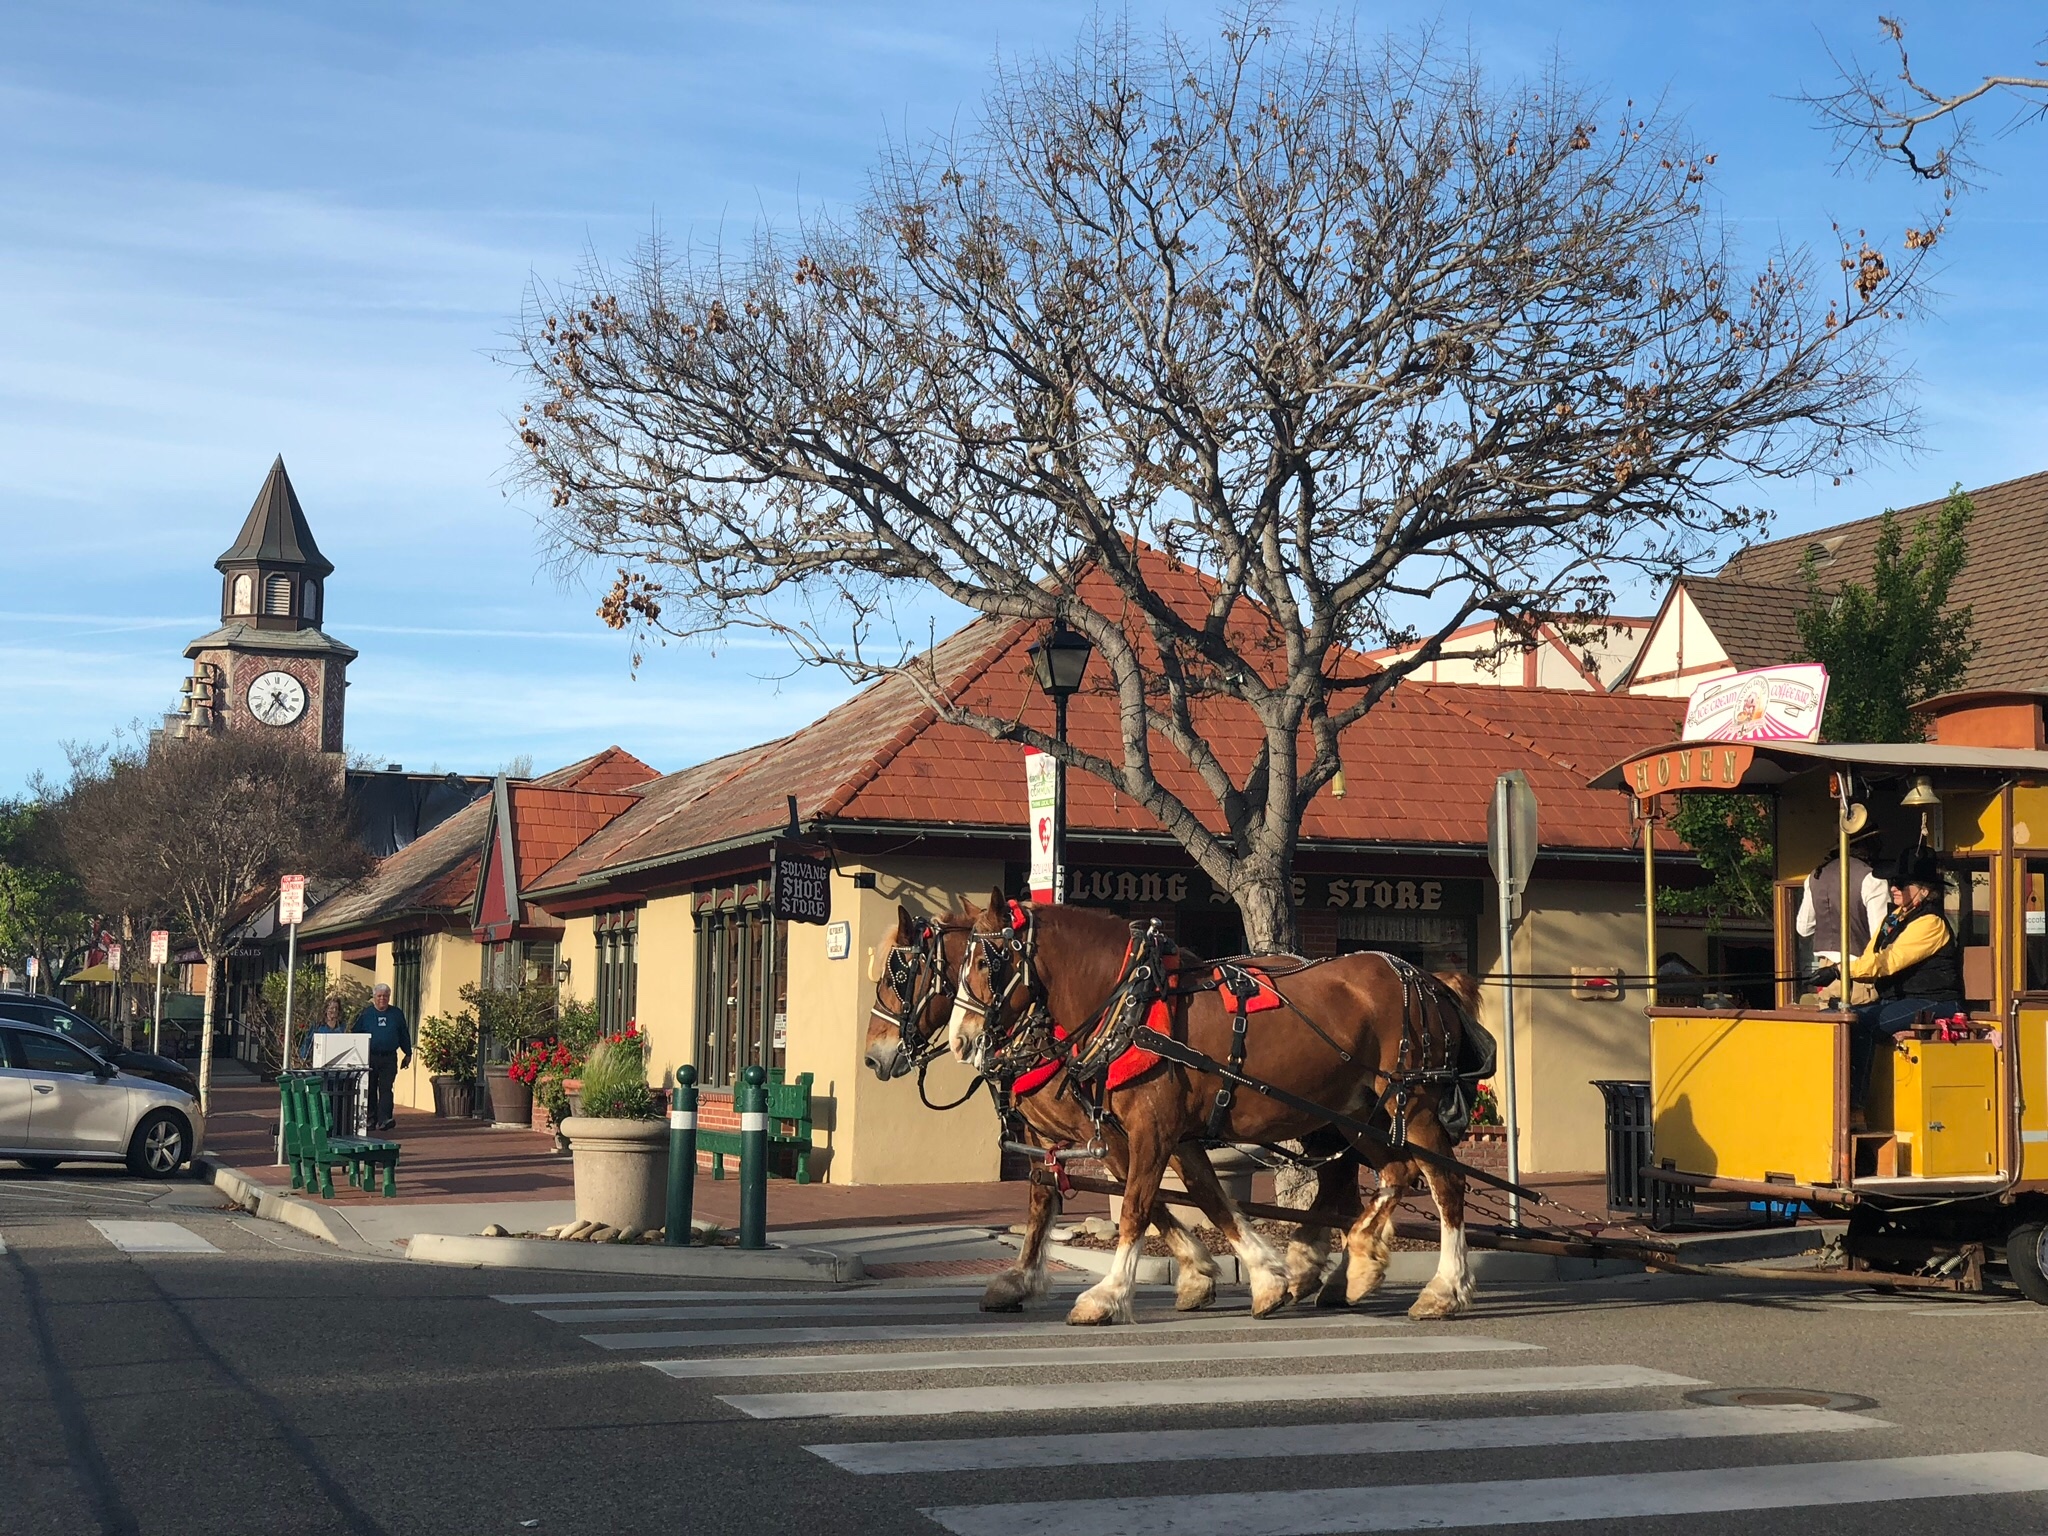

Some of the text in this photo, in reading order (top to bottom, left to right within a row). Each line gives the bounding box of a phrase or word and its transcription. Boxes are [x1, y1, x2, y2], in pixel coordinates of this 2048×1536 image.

[1697, 691, 1738, 719] ICE CREAM
[1795, 691, 1810, 704] BAR
[781, 860, 827, 880] SOLVANG
[782, 877, 824, 901] SHOE
[1327, 879, 1443, 910] STORE
[781, 897, 825, 917] STORE
